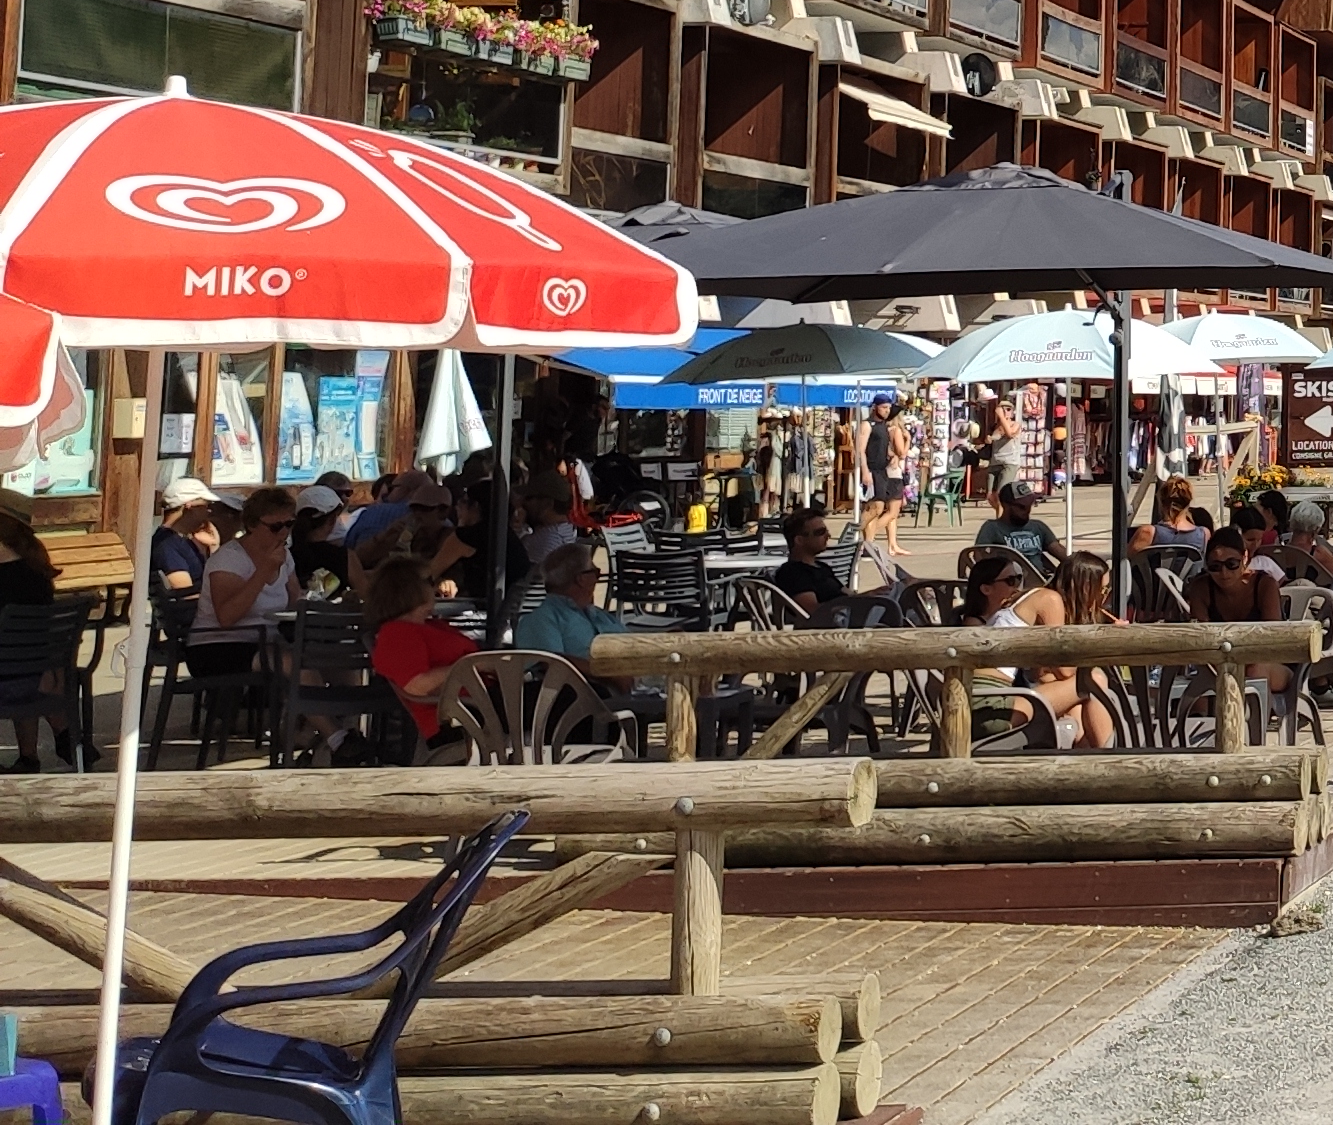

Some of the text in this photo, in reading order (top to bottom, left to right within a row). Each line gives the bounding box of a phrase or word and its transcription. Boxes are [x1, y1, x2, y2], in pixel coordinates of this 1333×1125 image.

[698, 388, 763, 404] FRONT DE NEIGE
